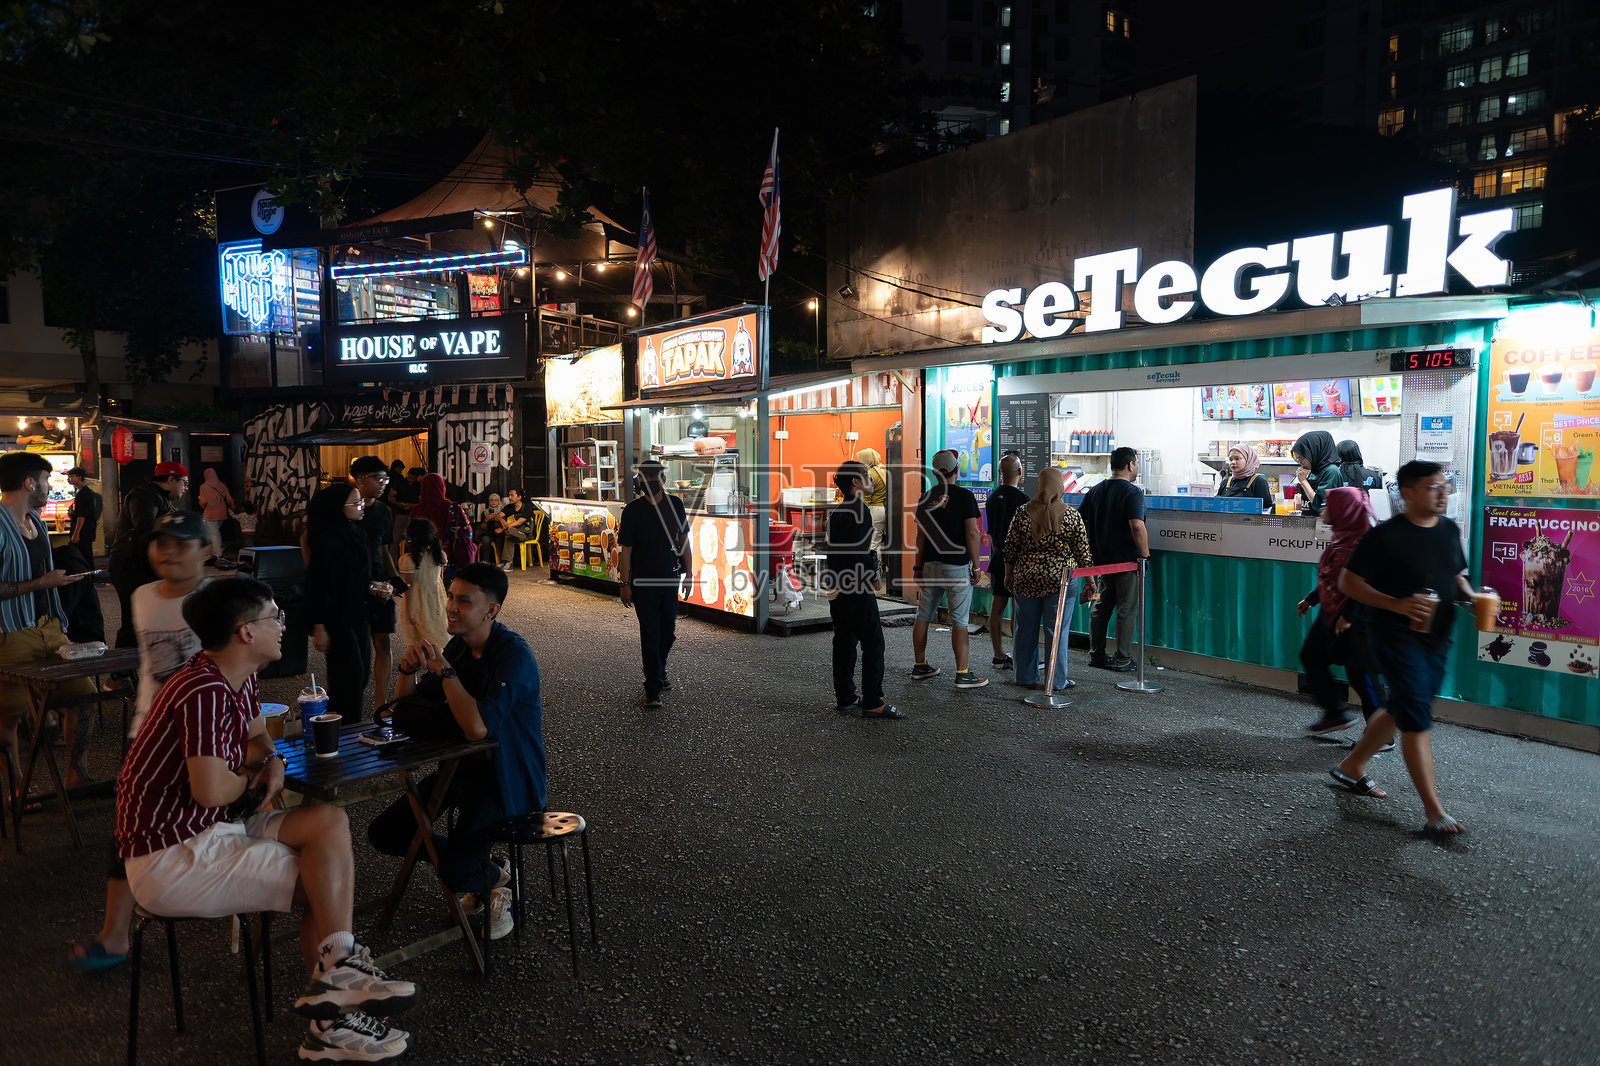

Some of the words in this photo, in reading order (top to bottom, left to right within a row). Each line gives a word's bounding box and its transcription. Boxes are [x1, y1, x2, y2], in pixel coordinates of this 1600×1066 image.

[340, 335, 416, 361] HOUSE
[420, 338, 438, 351] OF
[440, 330, 501, 359] VAPE
[663, 342, 725, 379] TAPAK
[1503, 344, 1600, 366] COFFEE
[409, 363, 428, 373] KLCC
[951, 383, 984, 394] JUICES
[1504, 415, 1510, 424] 7
[1553, 432, 1561, 443] 6
[1489, 516, 1600, 532] FRAPPUCCINO
[1159, 529, 1188, 540] ODER
[1189, 531, 1218, 542] HERE
[1268, 538, 1313, 549] PICKUP
[1502, 546, 1515, 556] 15
